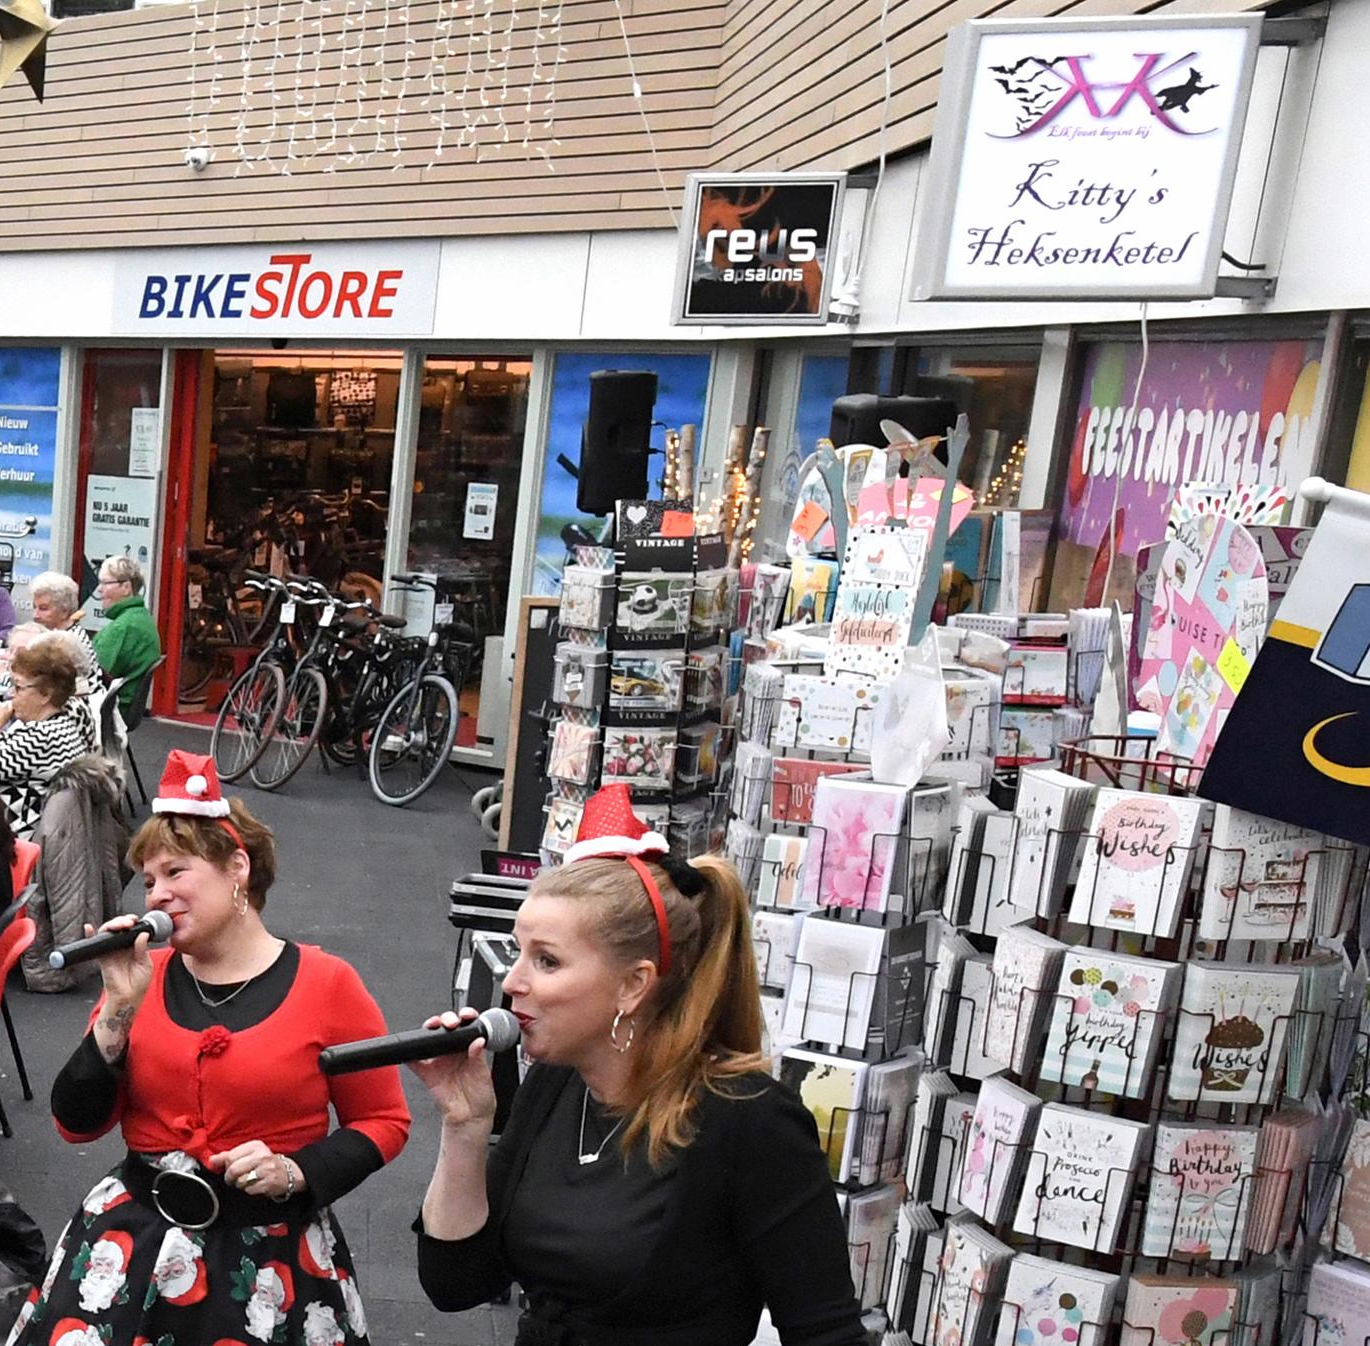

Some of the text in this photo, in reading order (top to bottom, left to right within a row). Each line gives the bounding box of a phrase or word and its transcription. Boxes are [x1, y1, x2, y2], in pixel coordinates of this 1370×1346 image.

[1047, 126, 1070, 138] Elk
[1135, 126, 1152, 139] bij
[1008, 159, 1169, 224] Kitty's
[704, 229, 818, 263] reus
[967, 220, 1200, 267] Heksenketel
[139, 253, 403, 319] BIKESTORE
[1082, 406, 1312, 498] FEESTARTIKELEN
[92, 501, 128, 513] NU 5 JAAR
[92, 514, 150, 528] GRATIS GARANTIE
[24, 548, 43, 559] van
[635, 539, 685, 547] VINTAGE
[1117, 817, 1170, 841] Birthday
[1095, 830, 1177, 865] Wishes
[1192, 1042, 1271, 1073] Wishes
[1067, 1151, 1093, 1162] DRINK
[1169, 1157, 1243, 1184] Birthday
[1035, 1173, 1105, 1204] dance
